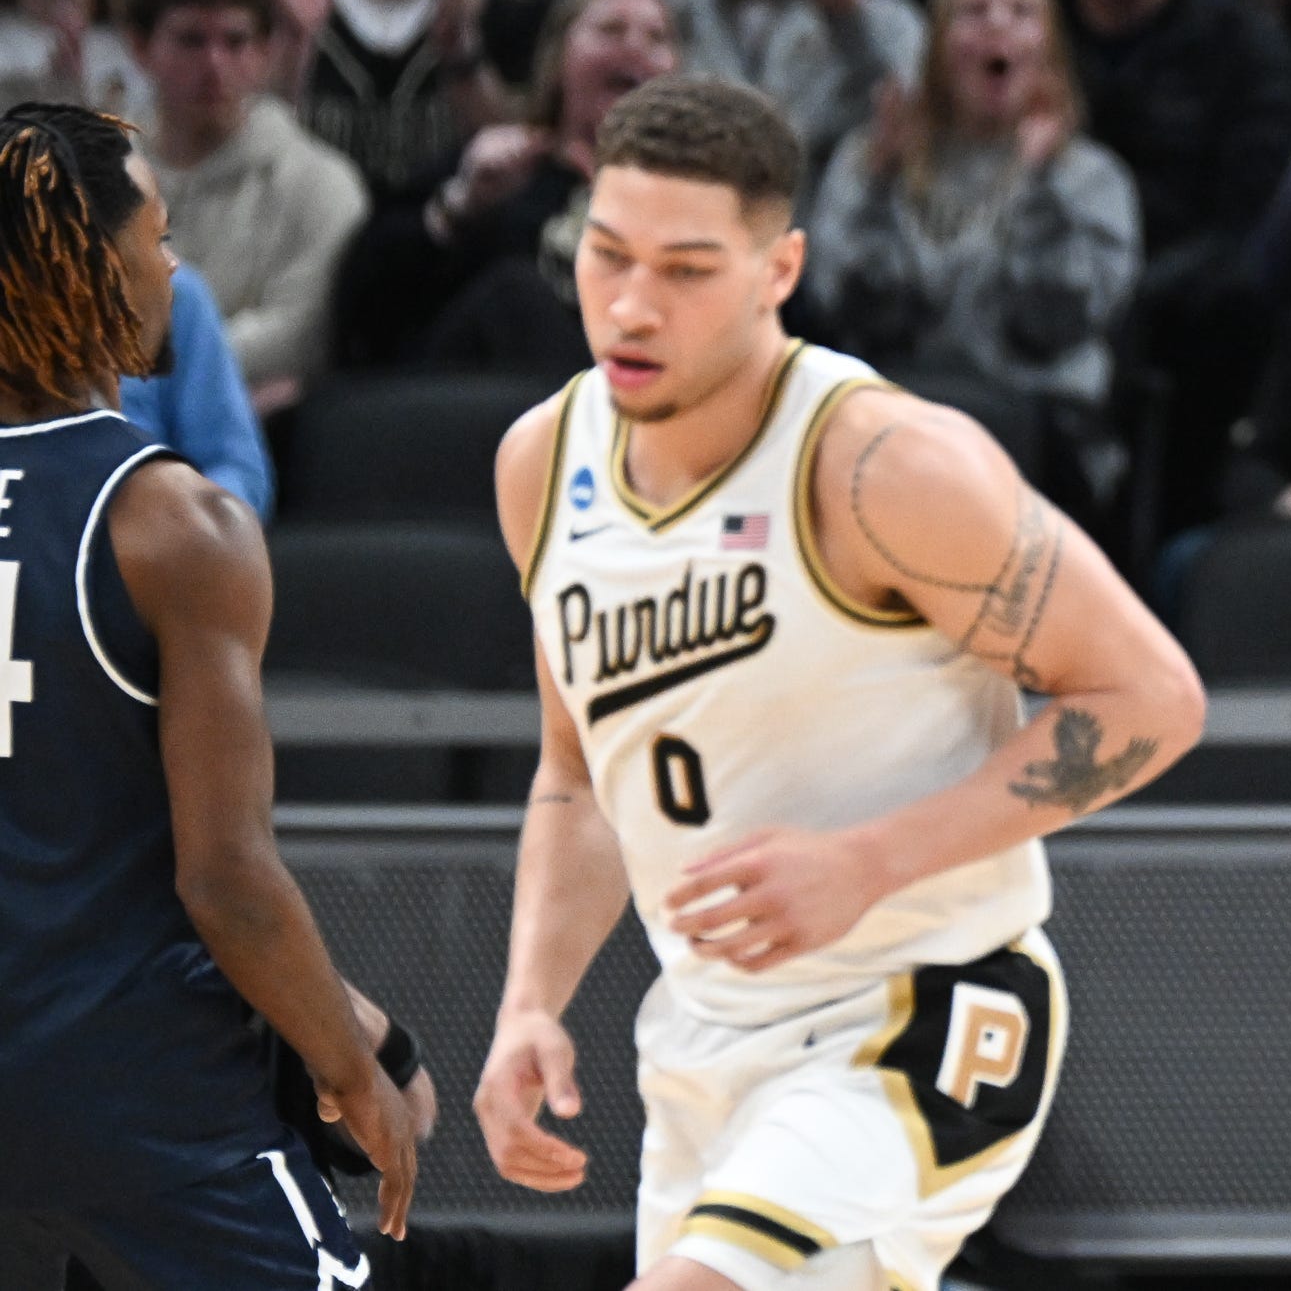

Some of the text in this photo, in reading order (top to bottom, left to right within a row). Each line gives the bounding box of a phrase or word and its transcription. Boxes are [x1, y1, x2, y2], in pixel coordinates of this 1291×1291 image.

[556, 558, 776, 686] Purdue
[652, 732, 711, 828] 0
[935, 980, 1032, 1110] P
